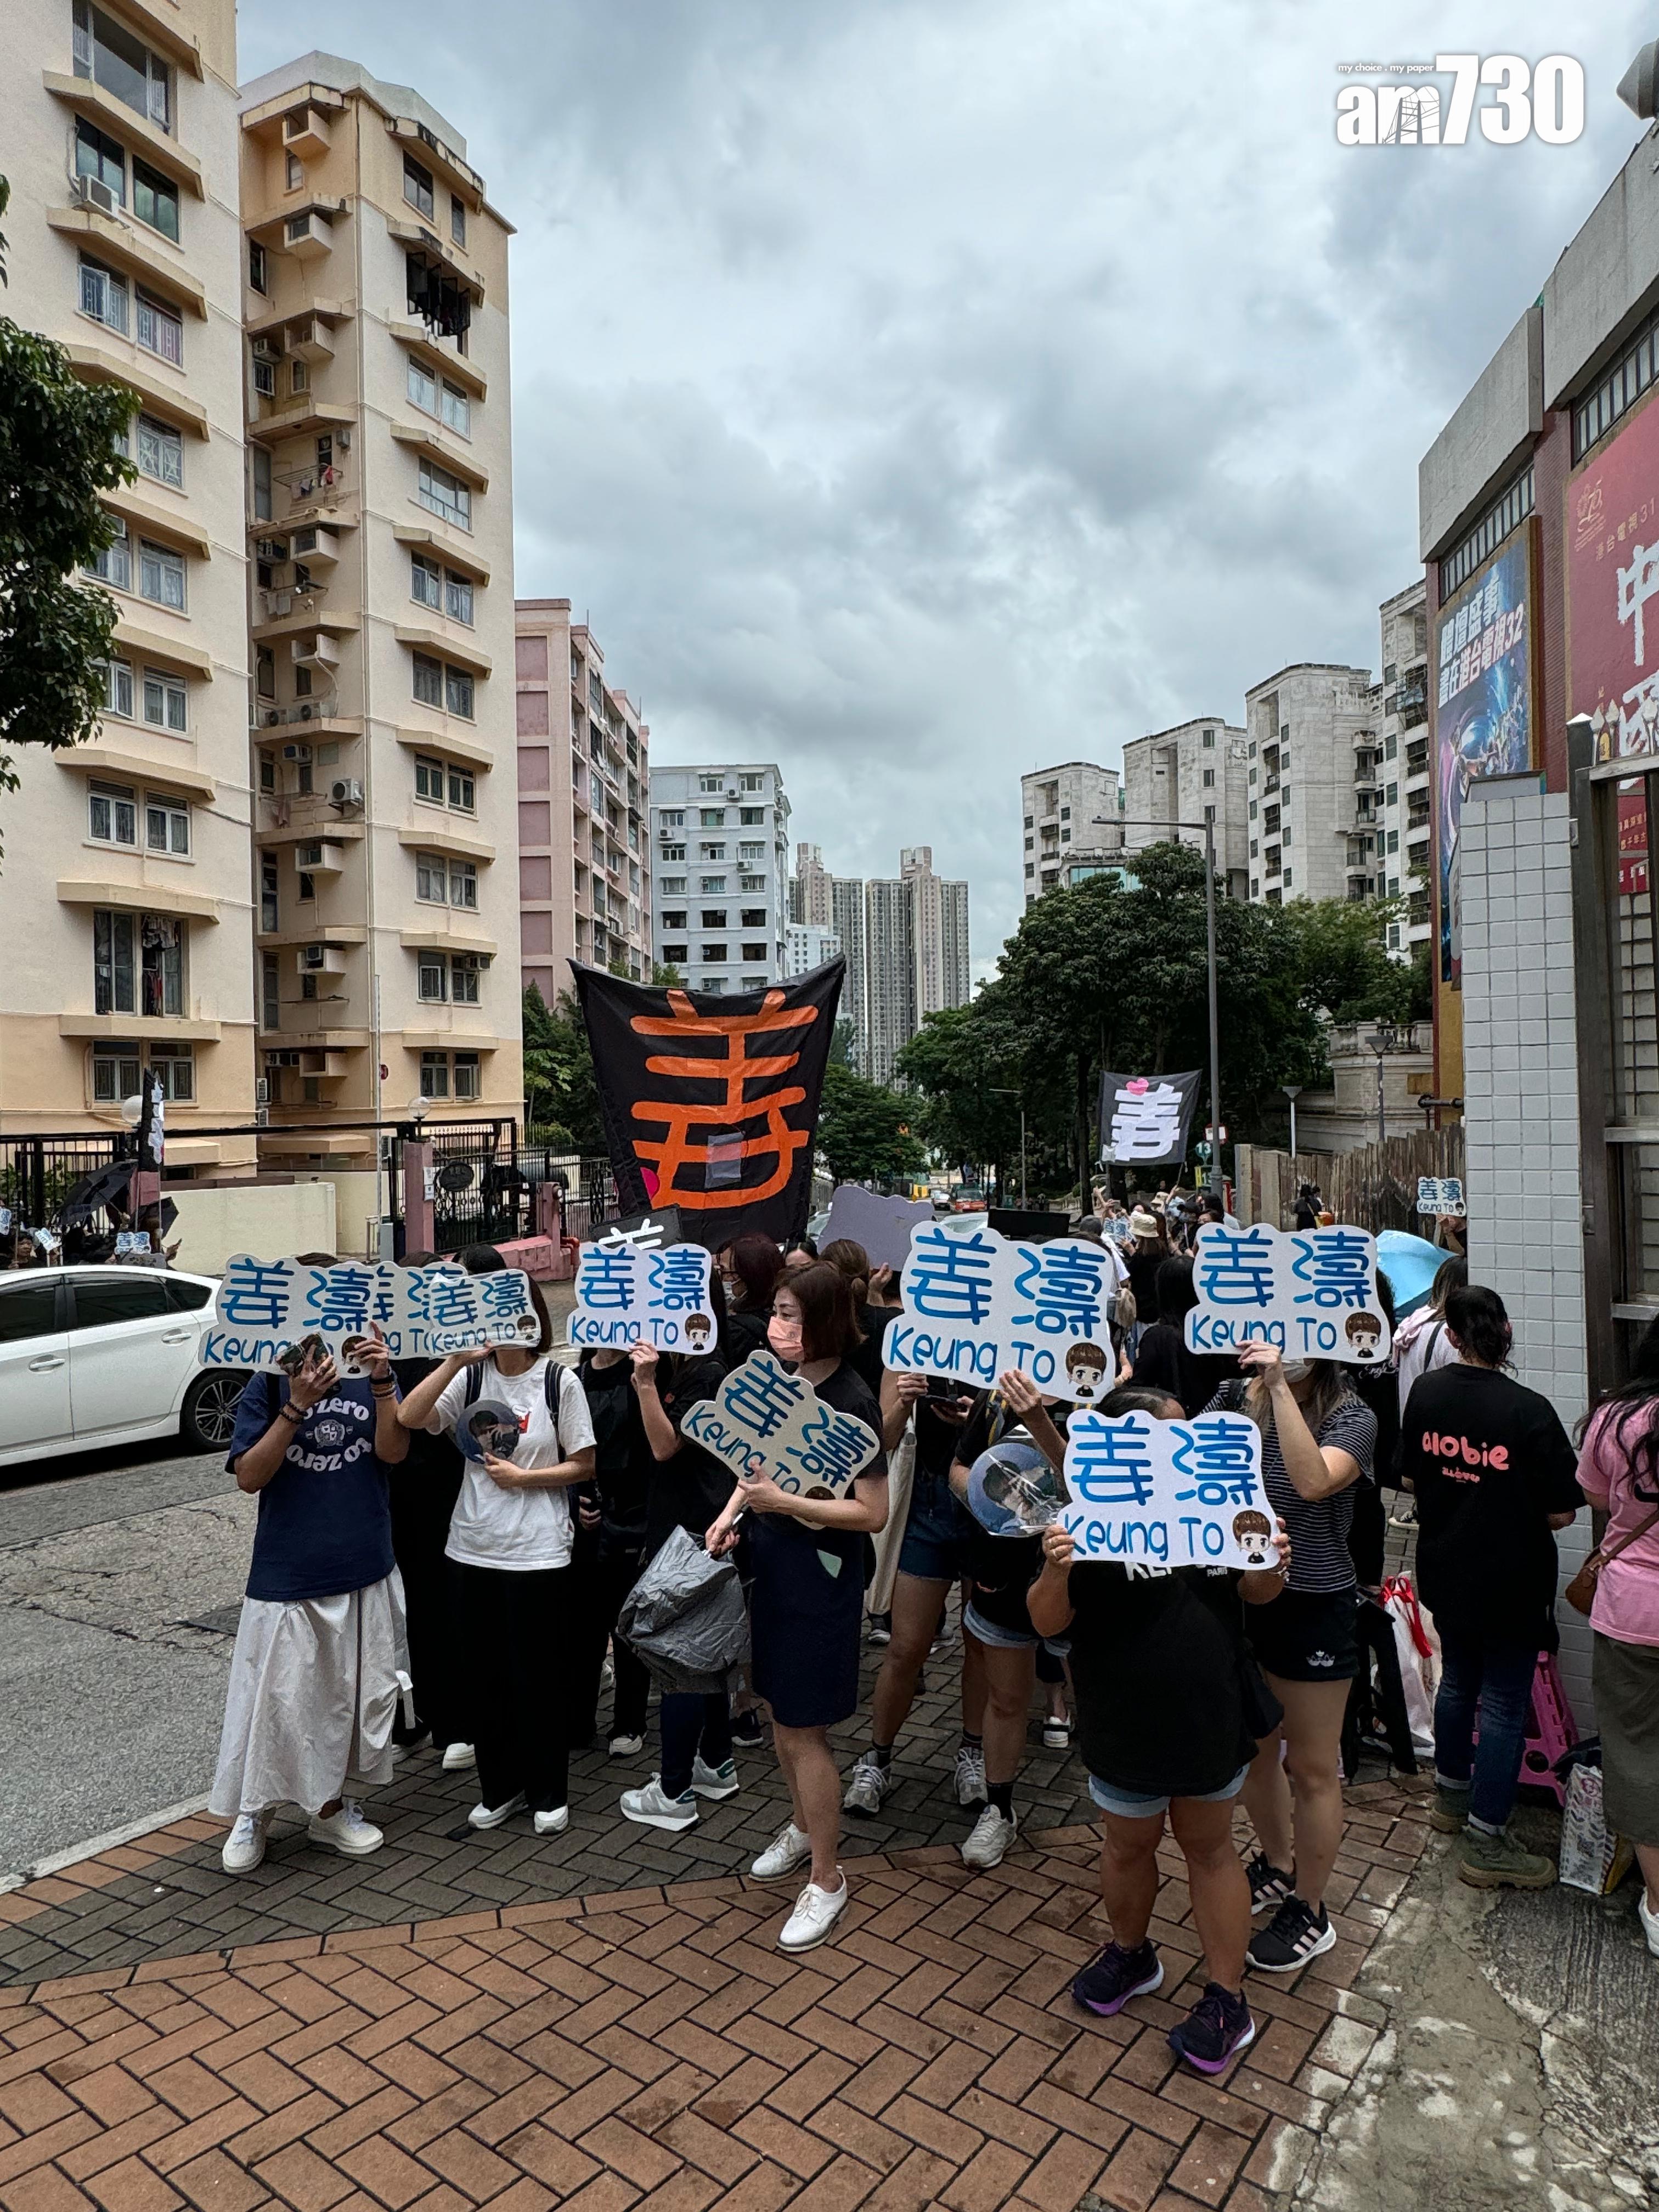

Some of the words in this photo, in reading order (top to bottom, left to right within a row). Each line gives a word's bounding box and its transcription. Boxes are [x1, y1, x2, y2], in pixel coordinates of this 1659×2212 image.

[630, 989, 819, 1210] 姜
[221, 1257, 375, 1333] 姜濤
[579, 1246, 706, 1311] 姜濤
[907, 1228, 1105, 1339] 姜濤
[1199, 1228, 1372, 1308] 姜濤
[431, 1272, 529, 1327] 姜濤
[492, 1322, 516, 1341] To
[648, 1318, 679, 1346] To
[889, 1323, 998, 1383] Keung
[1011, 1341, 1056, 1385] To
[1192, 1313, 1285, 1352] Keung
[1296, 1317, 1338, 1352] To
[314, 1397, 370, 1421] zero
[724, 1358, 876, 1488] 姜濤
[286, 1444, 343, 1472] zero
[1071, 1415, 1258, 1506] 姜濤
[1063, 1513, 1170, 1562] Keung
[1178, 1516, 1224, 1556] To
